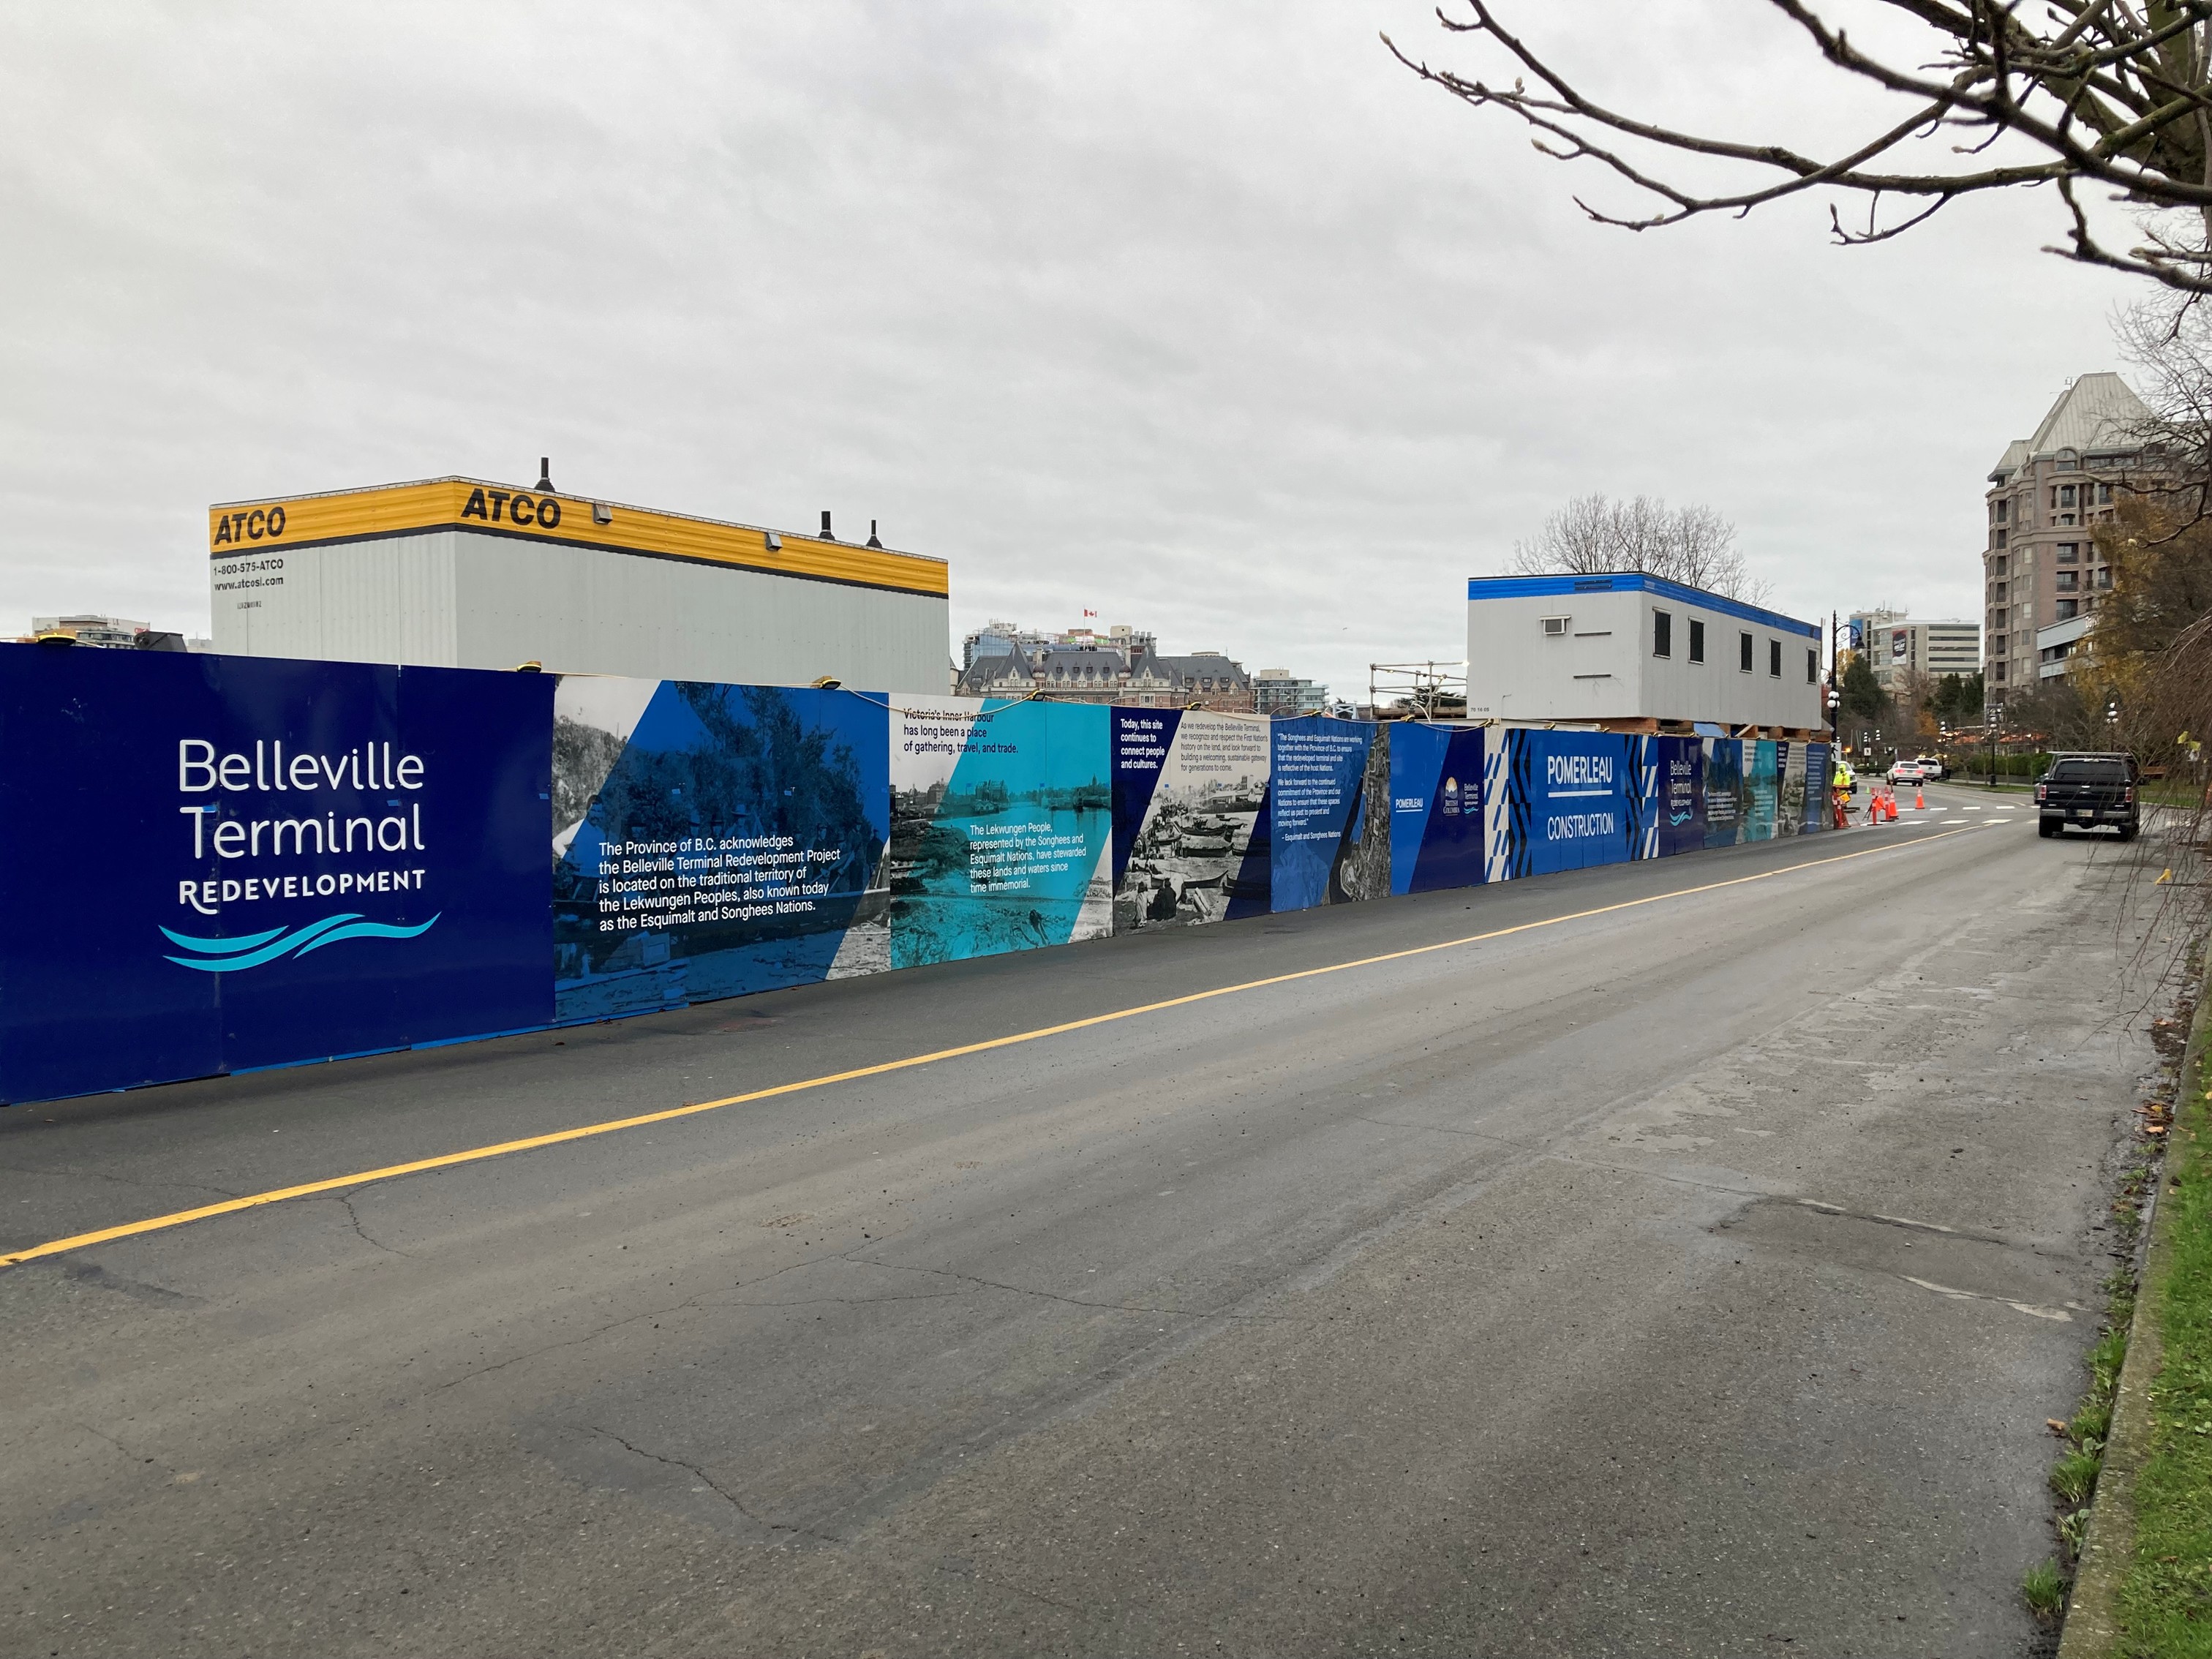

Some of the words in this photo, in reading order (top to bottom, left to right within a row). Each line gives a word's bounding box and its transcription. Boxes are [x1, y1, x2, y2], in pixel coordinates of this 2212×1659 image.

[461, 488, 561, 530] ATCO
[214, 506, 286, 545] ATCO
[214, 559, 283, 576] 1-800-575-ATCO
[943, 710, 962, 721] Inner
[964, 712, 994, 722] Harbour
[1121, 718, 1139, 731] Today,
[1140, 719, 1151, 729] this
[1153, 719, 1162, 729] site
[904, 724, 918, 735] has
[921, 725, 938, 739] long
[940, 726, 958, 737] been
[967, 727, 987, 740] place
[1195, 722, 1216, 731] redevelop
[1121, 731, 1149, 742] continues
[1150, 734, 1156, 742] to
[1189, 733, 1210, 742] recognize
[904, 740, 913, 751] of
[915, 741, 955, 755] gathering,
[958, 742, 981, 754] travel,
[982, 743, 996, 753] and
[998, 743, 1018, 753] trade.
[1121, 747, 1145, 755] connect
[1146, 746, 1165, 758] people
[1181, 742, 1196, 752] history
[179, 740, 424, 791] Belleville
[1121, 759, 1132, 768] and
[1133, 759, 1158, 768] cultures.
[1189, 764, 1214, 773] generations
[1548, 756, 1612, 785] POMERLEAU
[1671, 760, 1691, 775] Belleville
[1396, 798, 1423, 808] POMERLEAU
[180, 803, 425, 859] Terminal
[970, 825, 984, 835] The
[986, 824, 1025, 836] Lekwungen
[1028, 821, 1053, 835] People,
[1548, 813, 1614, 840] CONSTRUCTION
[599, 842, 622, 856] The
[626, 840, 677, 854] Province
[680, 839, 691, 851] of
[696, 838, 716, 851] B.C.
[720, 835, 793, 850] acknowledges
[970, 838, 1013, 852] represented
[1015, 838, 1023, 849] by
[1026, 837, 1036, 846] the
[1038, 835, 1070, 848] Songhees
[1072, 833, 1083, 843] and
[599, 861, 619, 875] the
[623, 857, 674, 873] Belleville
[677, 854, 722, 869] Terminal
[726, 851, 804, 867] Redevelopment
[808, 849, 840, 863] Project
[971, 851, 1005, 866] Esquimalt
[1007, 850, 1034, 861] Nations,
[1037, 849, 1051, 859] have
[1053, 846, 1086, 858] stewarded
[970, 868, 991, 879] these
[993, 866, 1012, 877] lands
[1014, 864, 1026, 875] and
[1028, 864, 1049, 873] waters
[1051, 862, 1068, 872] since
[599, 880, 609, 893] is
[613, 876, 656, 892] located
[660, 878, 674, 889] on
[677, 874, 696, 887] the
[699, 870, 751, 887] traditional
[754, 868, 794, 883] territory
[797, 866, 807, 879] of
[971, 882, 986, 893] time
[988, 878, 1030, 892] immemorial.
[179, 870, 425, 914] REDEVELOPMENT
[599, 898, 620, 912] the
[623, 895, 691, 910] Lekwungen
[694, 889, 740, 906] Peoples,
[743, 887, 764, 900] also
[767, 885, 800, 898] known
[802, 882, 829, 896] today
[600, 919, 614, 931] as
[617, 915, 636, 929] the
[641, 909, 695, 929] Esquimalt
[698, 907, 718, 922] and
[721, 904, 773, 921] Songhees
[776, 900, 816, 914] Nations.
